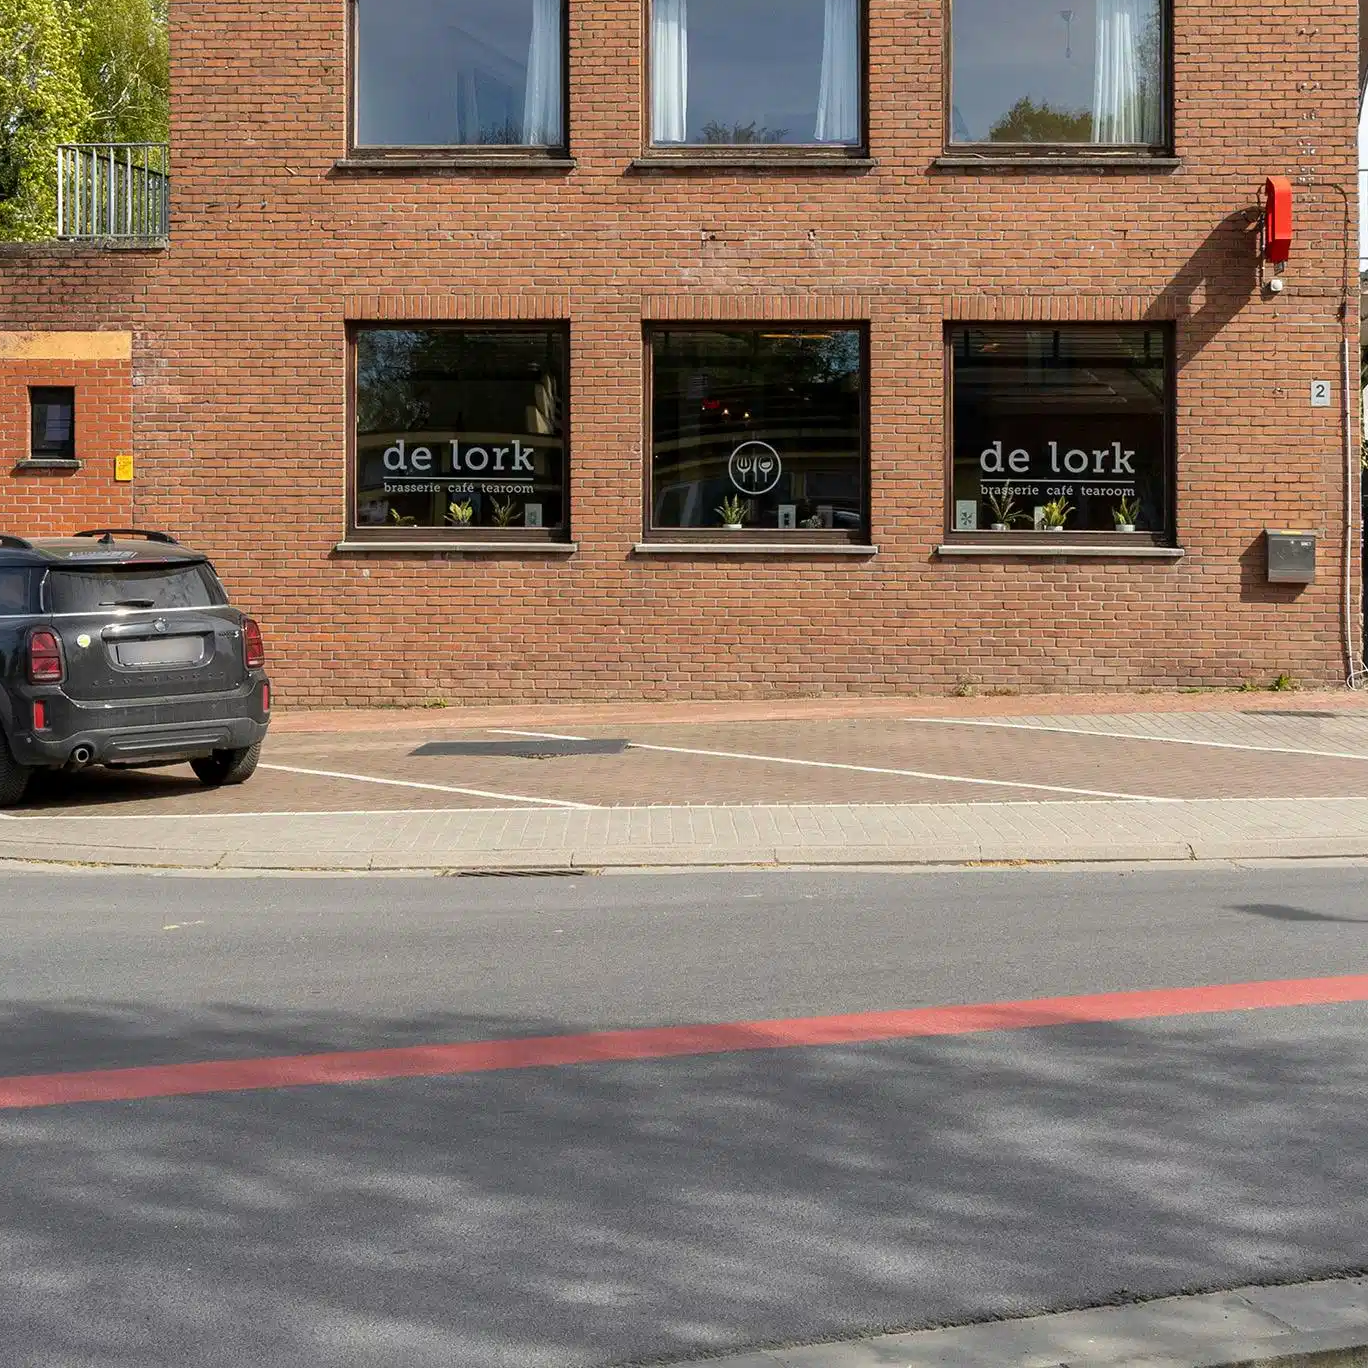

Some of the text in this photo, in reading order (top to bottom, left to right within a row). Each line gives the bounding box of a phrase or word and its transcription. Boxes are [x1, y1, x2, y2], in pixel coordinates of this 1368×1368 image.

[1315, 384, 1325, 398] 2
[383, 440, 534, 471] de lork
[980, 440, 1135, 473] de lork
[384, 482, 534, 494] brasserie café tearoom
[981, 485, 1135, 497] brasserie café tearoom
